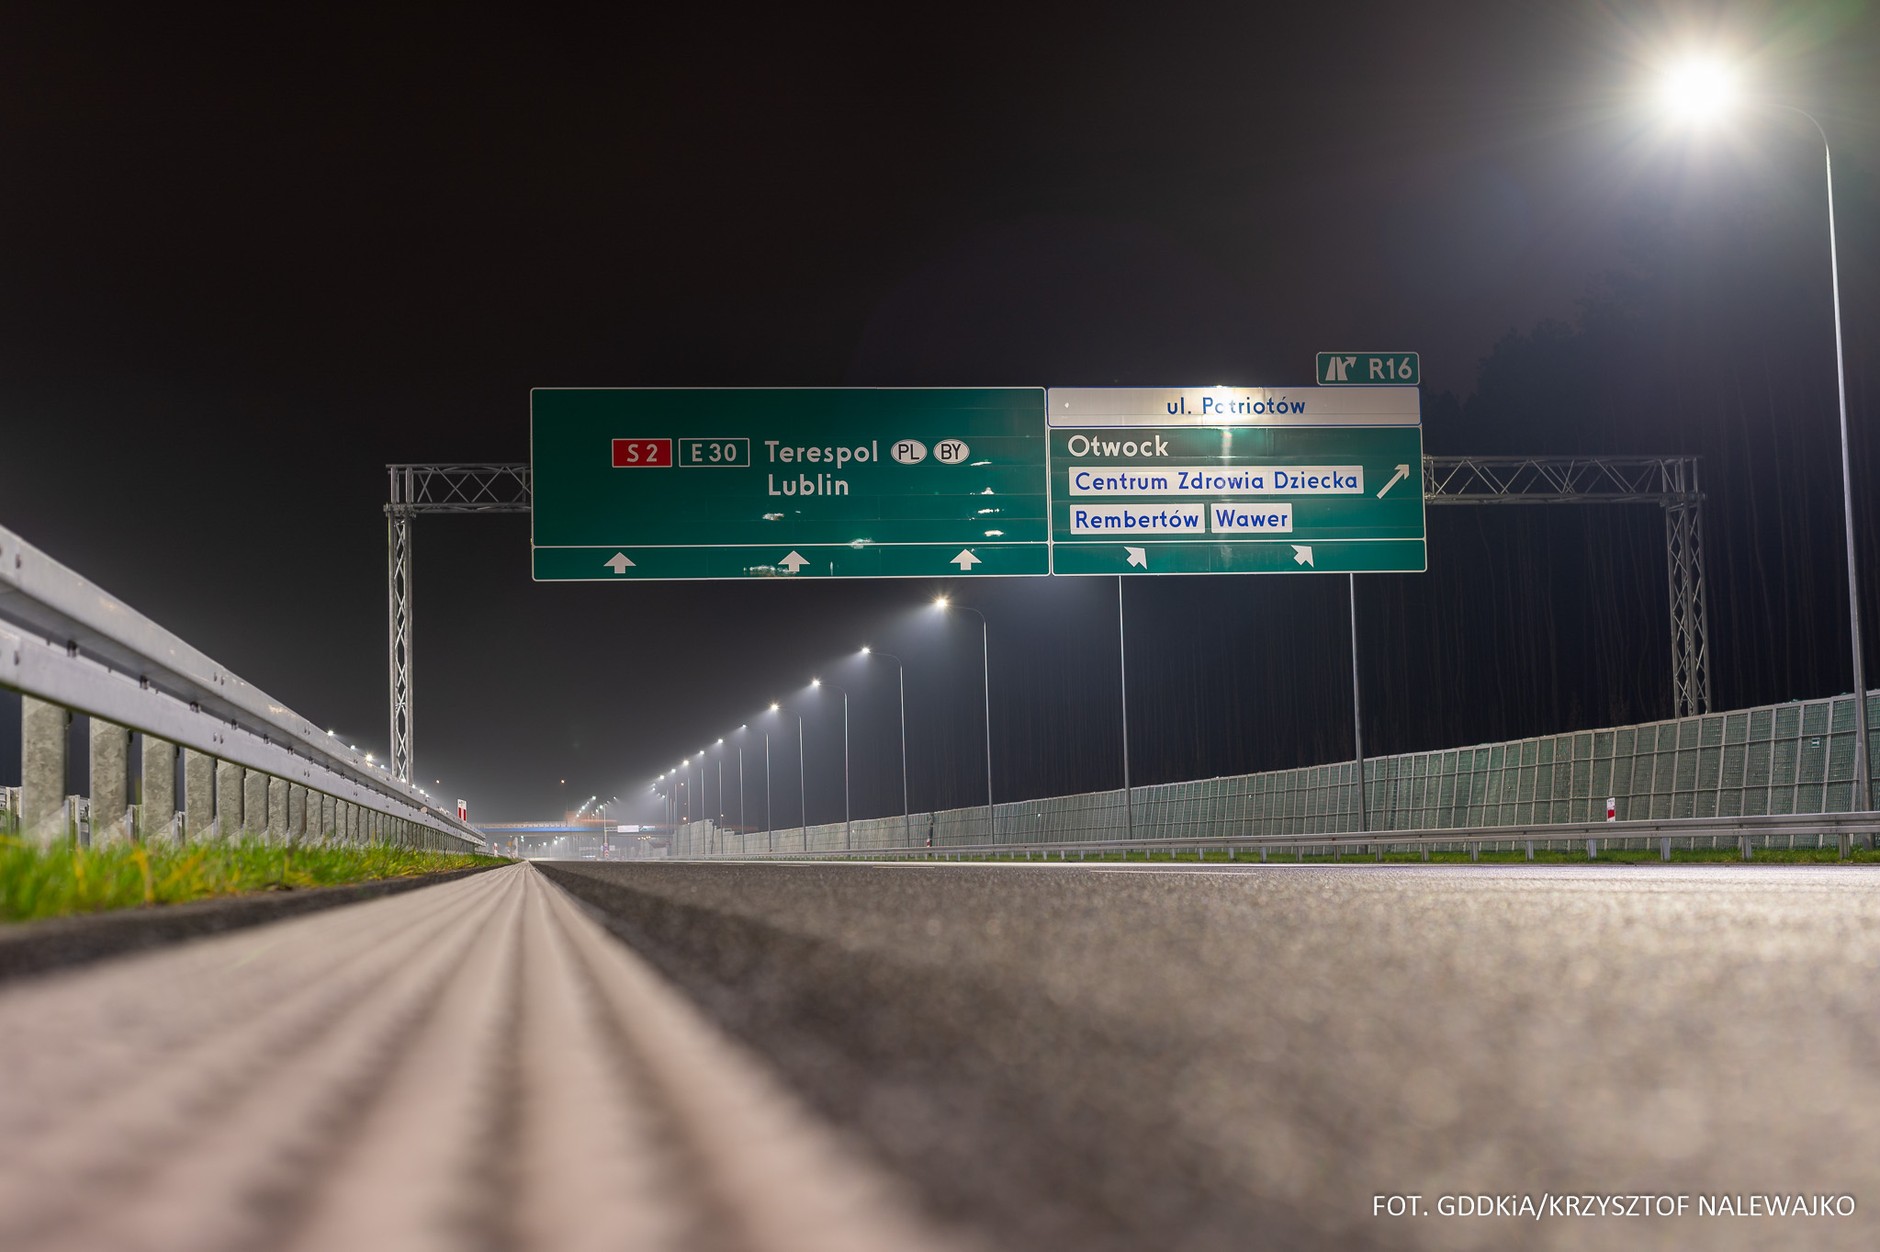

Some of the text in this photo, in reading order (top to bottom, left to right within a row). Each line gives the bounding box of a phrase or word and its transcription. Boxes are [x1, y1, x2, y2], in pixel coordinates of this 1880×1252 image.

[1368, 357, 1413, 380] R16
[1167, 396, 1192, 415] ul.
[764, 439, 879, 469] Terespol
[897, 443, 920, 461] PL
[941, 443, 963, 461] BY
[1067, 434, 1169, 457] Otwock
[768, 472, 849, 497] Lublin
[1075, 470, 1358, 491] Centrum Zdrowia Dziecka
[1075, 509, 1200, 530] Rembertów
[1216, 509, 1289, 529] Wawer
